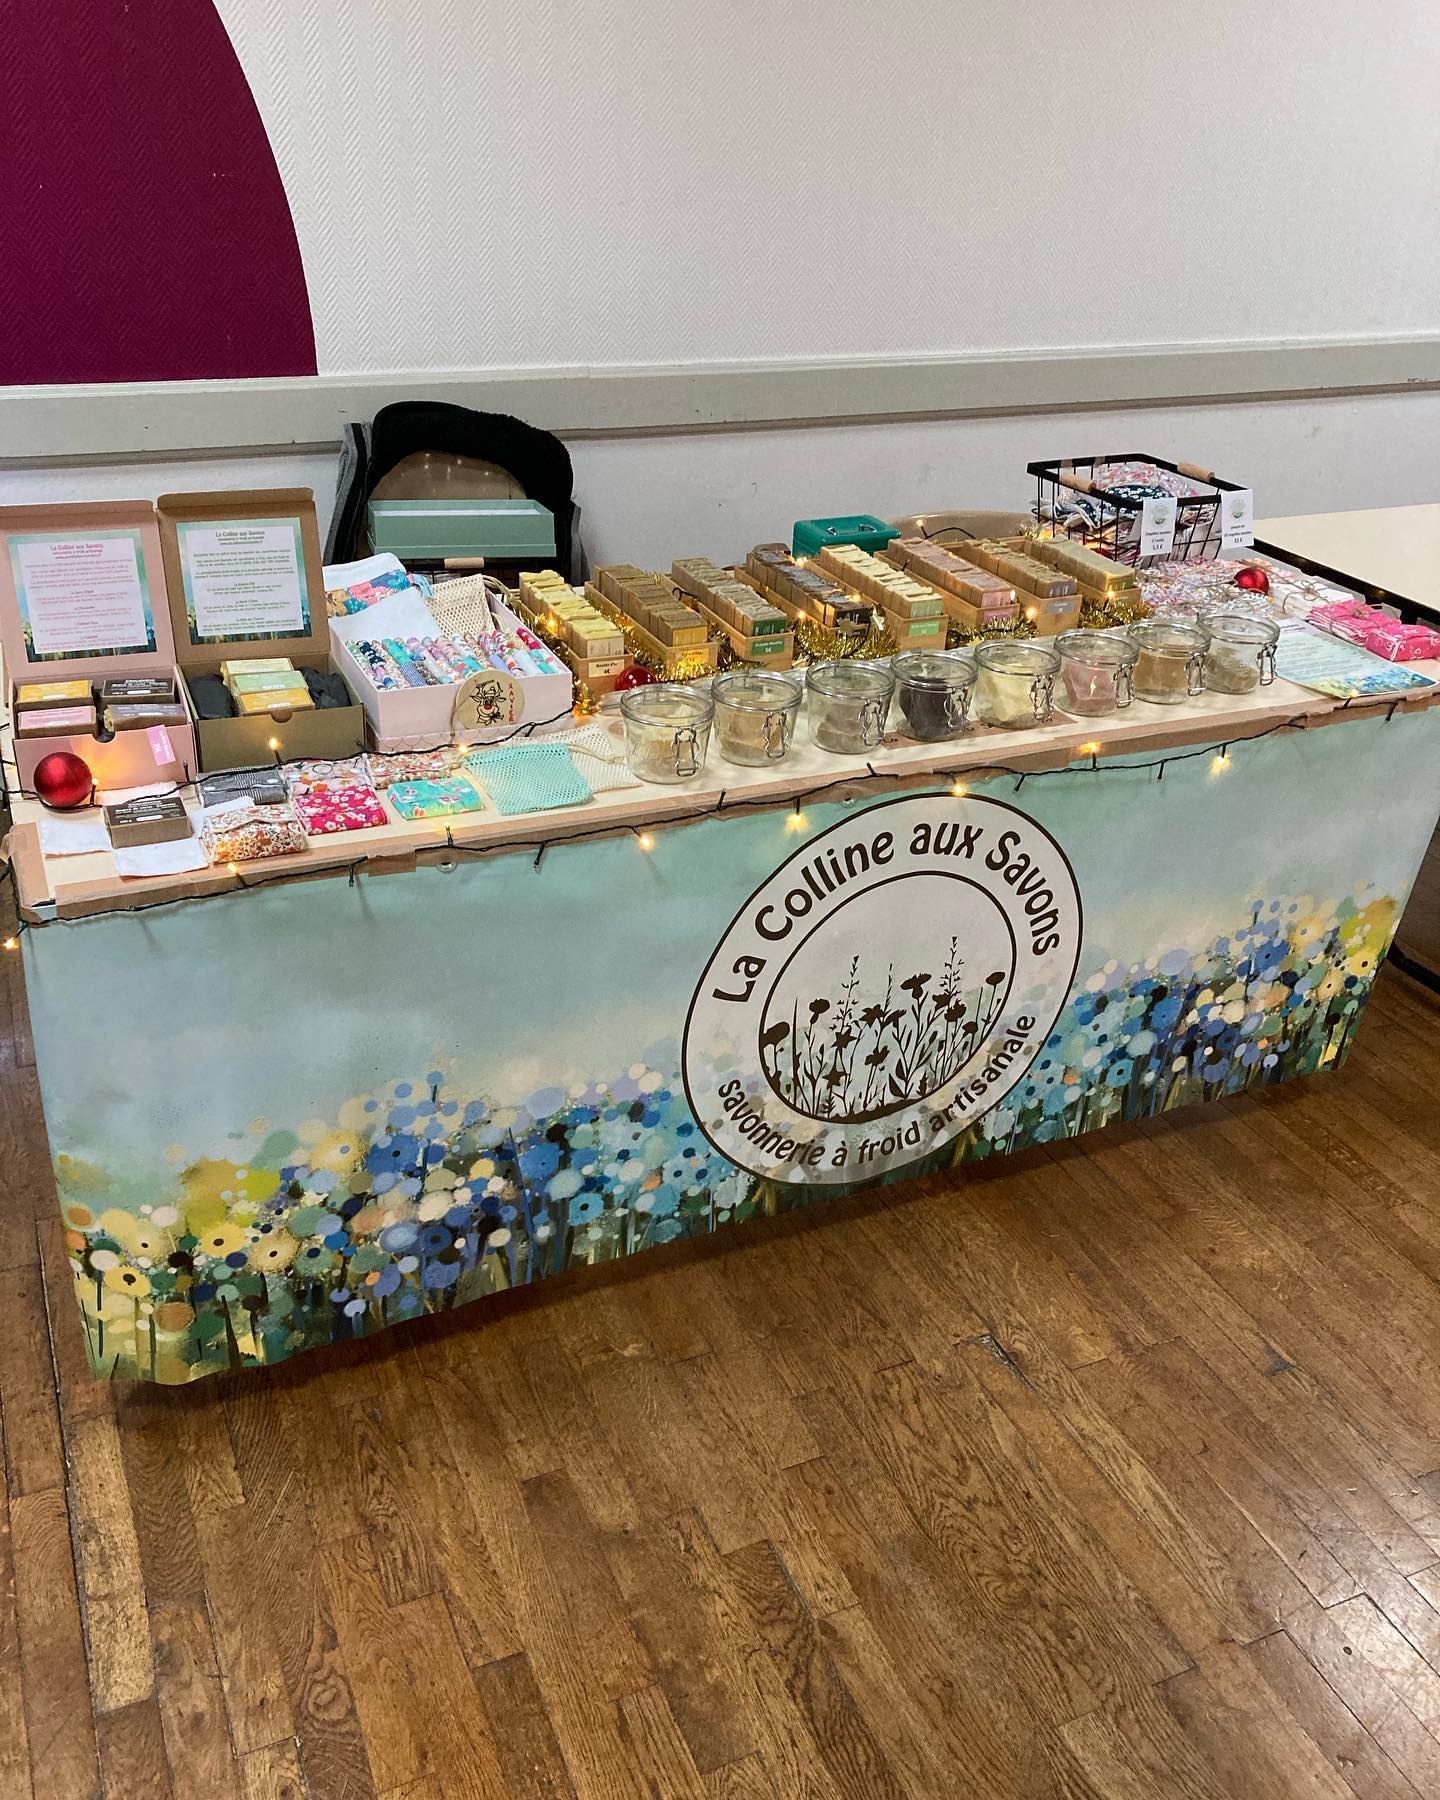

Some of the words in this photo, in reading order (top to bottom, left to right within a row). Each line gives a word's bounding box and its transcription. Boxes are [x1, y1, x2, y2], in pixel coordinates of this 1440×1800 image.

[713, 955, 767, 1003] La
[754, 831, 895, 942] Colline
[909, 822, 984, 860] aux
[985, 830, 1060, 956] Savons
[718, 1079, 826, 1166] savonnerie
[831, 1141, 848, 1167] à
[858, 1120, 921, 1164] froid
[929, 1015, 1036, 1132] artisanale
